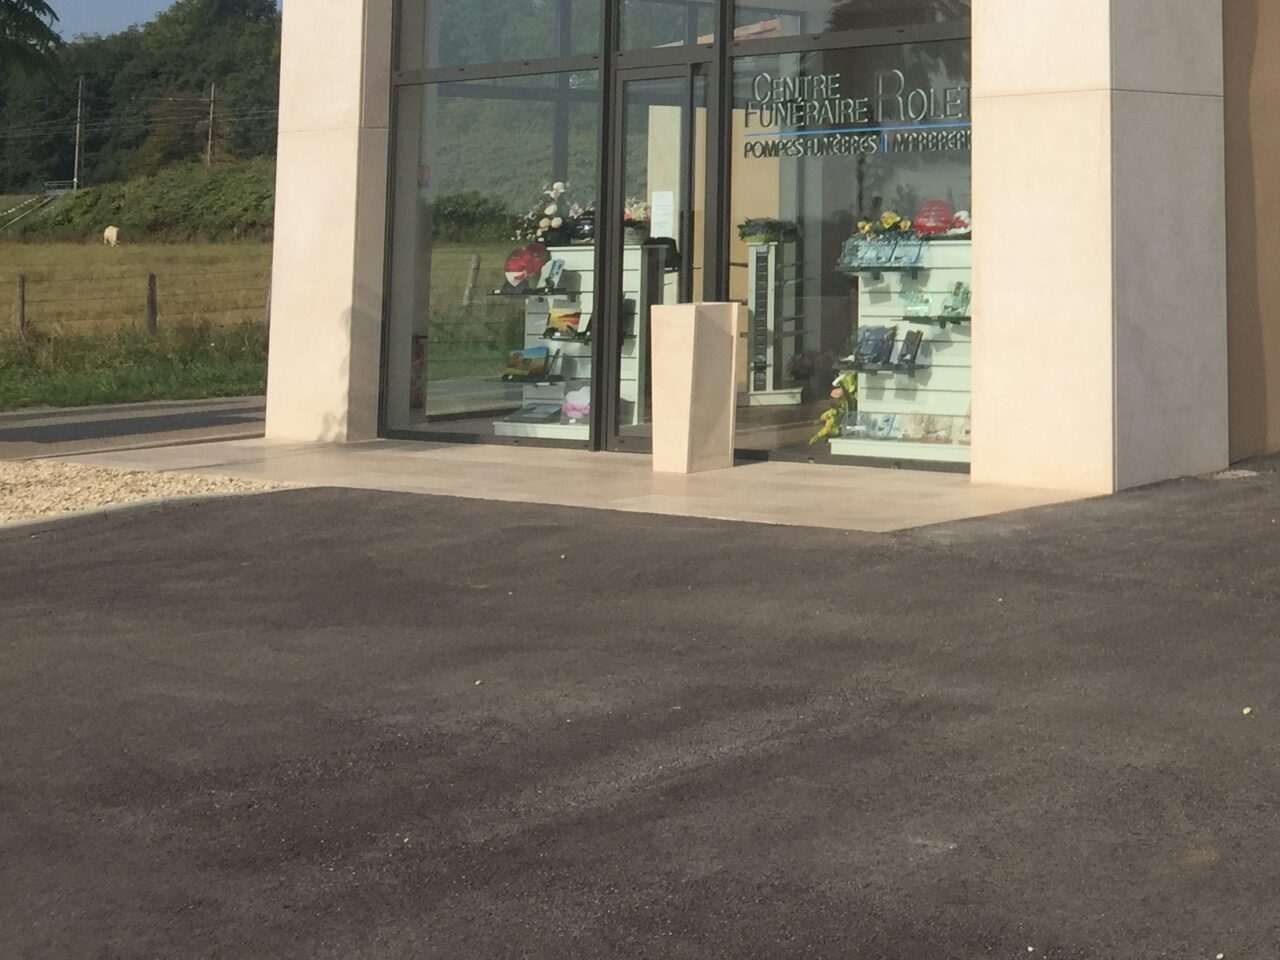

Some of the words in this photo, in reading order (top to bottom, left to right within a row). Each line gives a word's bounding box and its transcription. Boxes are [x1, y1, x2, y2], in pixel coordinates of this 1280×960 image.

[753, 72, 841, 103] CENTRE
[744, 96, 869, 128] FUNÉRAIRE
[744, 137, 803, 158] POMPES
[893, 129, 971, 153] MARBRERI
